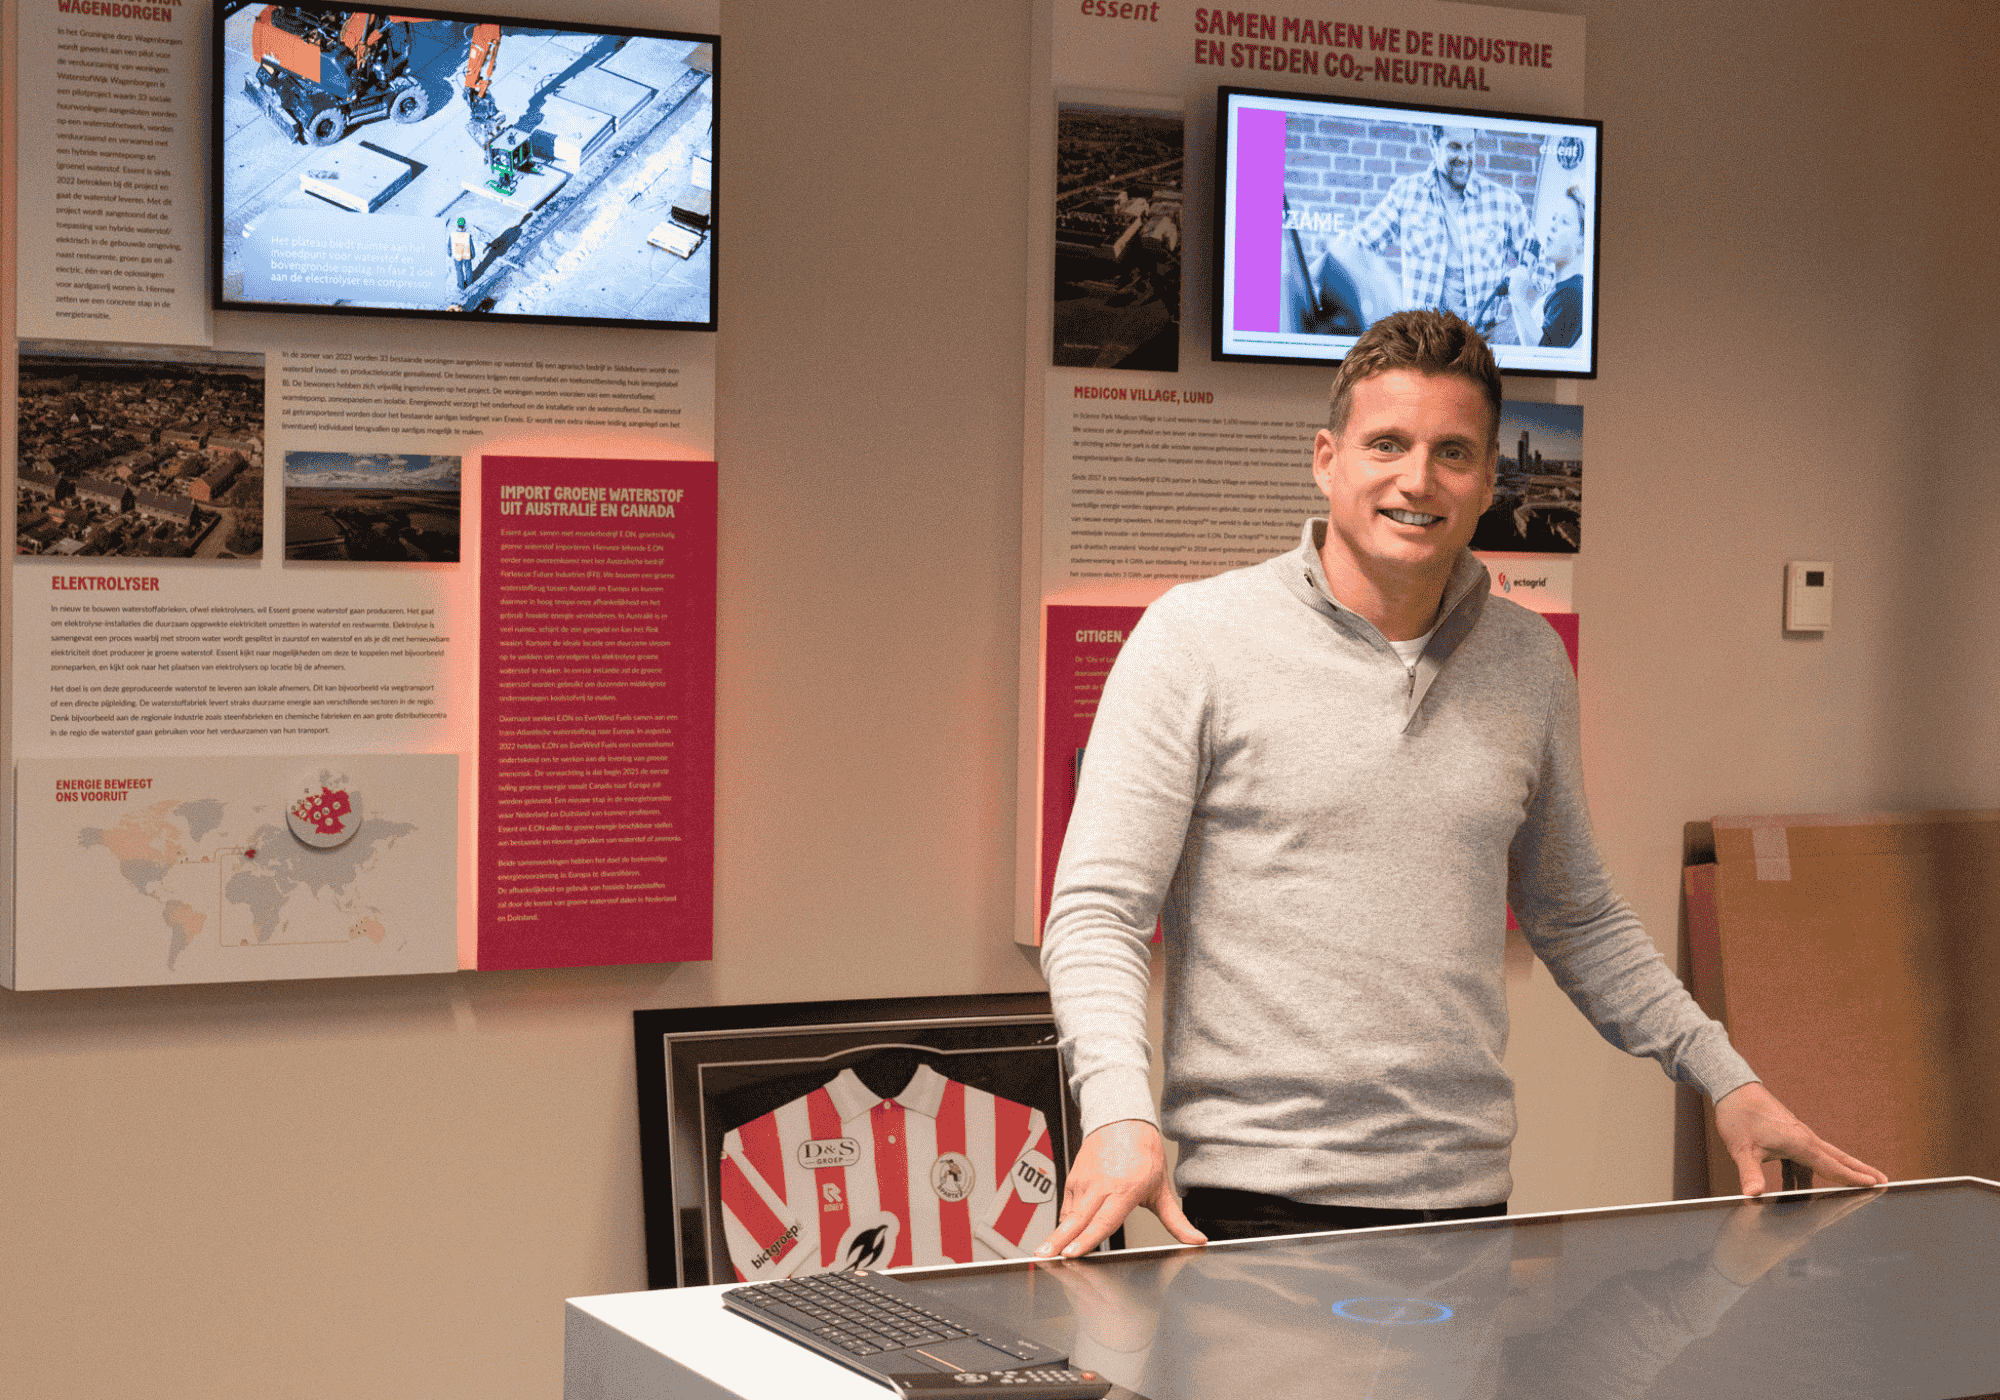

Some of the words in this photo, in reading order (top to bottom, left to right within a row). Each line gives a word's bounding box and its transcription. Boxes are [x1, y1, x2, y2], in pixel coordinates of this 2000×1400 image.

[59, 0, 171, 21] WAGENBORGEN
[1081, 0, 1160, 22] essent
[1194, 7, 1276, 40] SAMEN
[1282, 16, 1363, 49] MAKEN
[1368, 25, 1400, 53] WE
[1406, 30, 1433, 56] DE
[1438, 32, 1552, 69] INDUSTRIE
[1194, 38, 1225, 66] EN
[1230, 42, 1319, 75] STEDEN
[271, 237, 288, 246] Het
[292, 238, 327, 250] plateau
[355, 253, 398, 263] waterstof
[271, 261, 339, 274] bovengrondse
[377, 265, 385, 274] In
[388, 266, 406, 275] fase
[289, 273, 303, 282] de
[305, 274, 362, 287] electrolyser
[1073, 385, 1127, 401] MEDICON
[1130, 388, 1181, 405] VILLAGE,
[1183, 391, 1214, 404] LUND
[500, 485, 551, 500] IMPORT
[554, 486, 606, 502] GROENE
[608, 487, 684, 503] WATERSTOF
[500, 501, 522, 515] UIT
[525, 500, 597, 517] AUSTRALIË
[600, 503, 618, 517] EN
[620, 503, 675, 518] CANADA
[51, 576, 160, 591] ELEKTROLYSER
[51, 604, 58, 612] In
[60, 604, 80, 612] nieuw
[83, 604, 89, 612] te
[92, 604, 119, 612] bouwen
[190, 605, 209, 613] ofwel
[257, 605, 267, 613] wil
[269, 605, 290, 613] Essent
[292, 608, 315, 616] groene
[317, 606, 348, 614] waterstof
[350, 608, 364, 616] gaan
[407, 606, 419, 614] Het
[420, 606, 435, 616] gaat
[51, 634, 92, 644] samengevat
[109, 636, 132, 644] proces
[135, 634, 159, 644] waarbij
[161, 634, 173, 642] met
[176, 634, 200, 642] stroom
[202, 634, 220, 642] water
[224, 634, 243, 642] wordt
[245, 634, 272, 644] gesplitst
[275, 634, 280, 642] in
[283, 634, 309, 642] zuurstof
[322, 634, 352, 642] waterstof
[364, 634, 372, 642] als
[374, 634, 379, 644] je
[382, 634, 390, 642] dit
[392, 634, 404, 642] met
[406, 634, 450, 642] hernieuwbare
[110, 663, 124, 673] kijkt
[127, 663, 139, 671] ook
[158, 663, 169, 671] het
[171, 663, 199, 673] plaatsen
[216, 663, 258, 673] elektrolysers
[260, 665, 268, 673] op
[271, 663, 292, 671] locatie
[294, 663, 302, 673] bij
[304, 663, 312, 671] de
[56, 779, 102, 790] ENERGIE
[104, 778, 153, 790] BEWEEGT
[56, 791, 79, 802] ONS
[80, 791, 128, 802] VOORUIT
[804, 1141, 855, 1158] D&S
[816, 1157, 843, 1165] GROEP
[1017, 1160, 1053, 1194] TOTO
[751, 1225, 799, 1269] bictgroep
